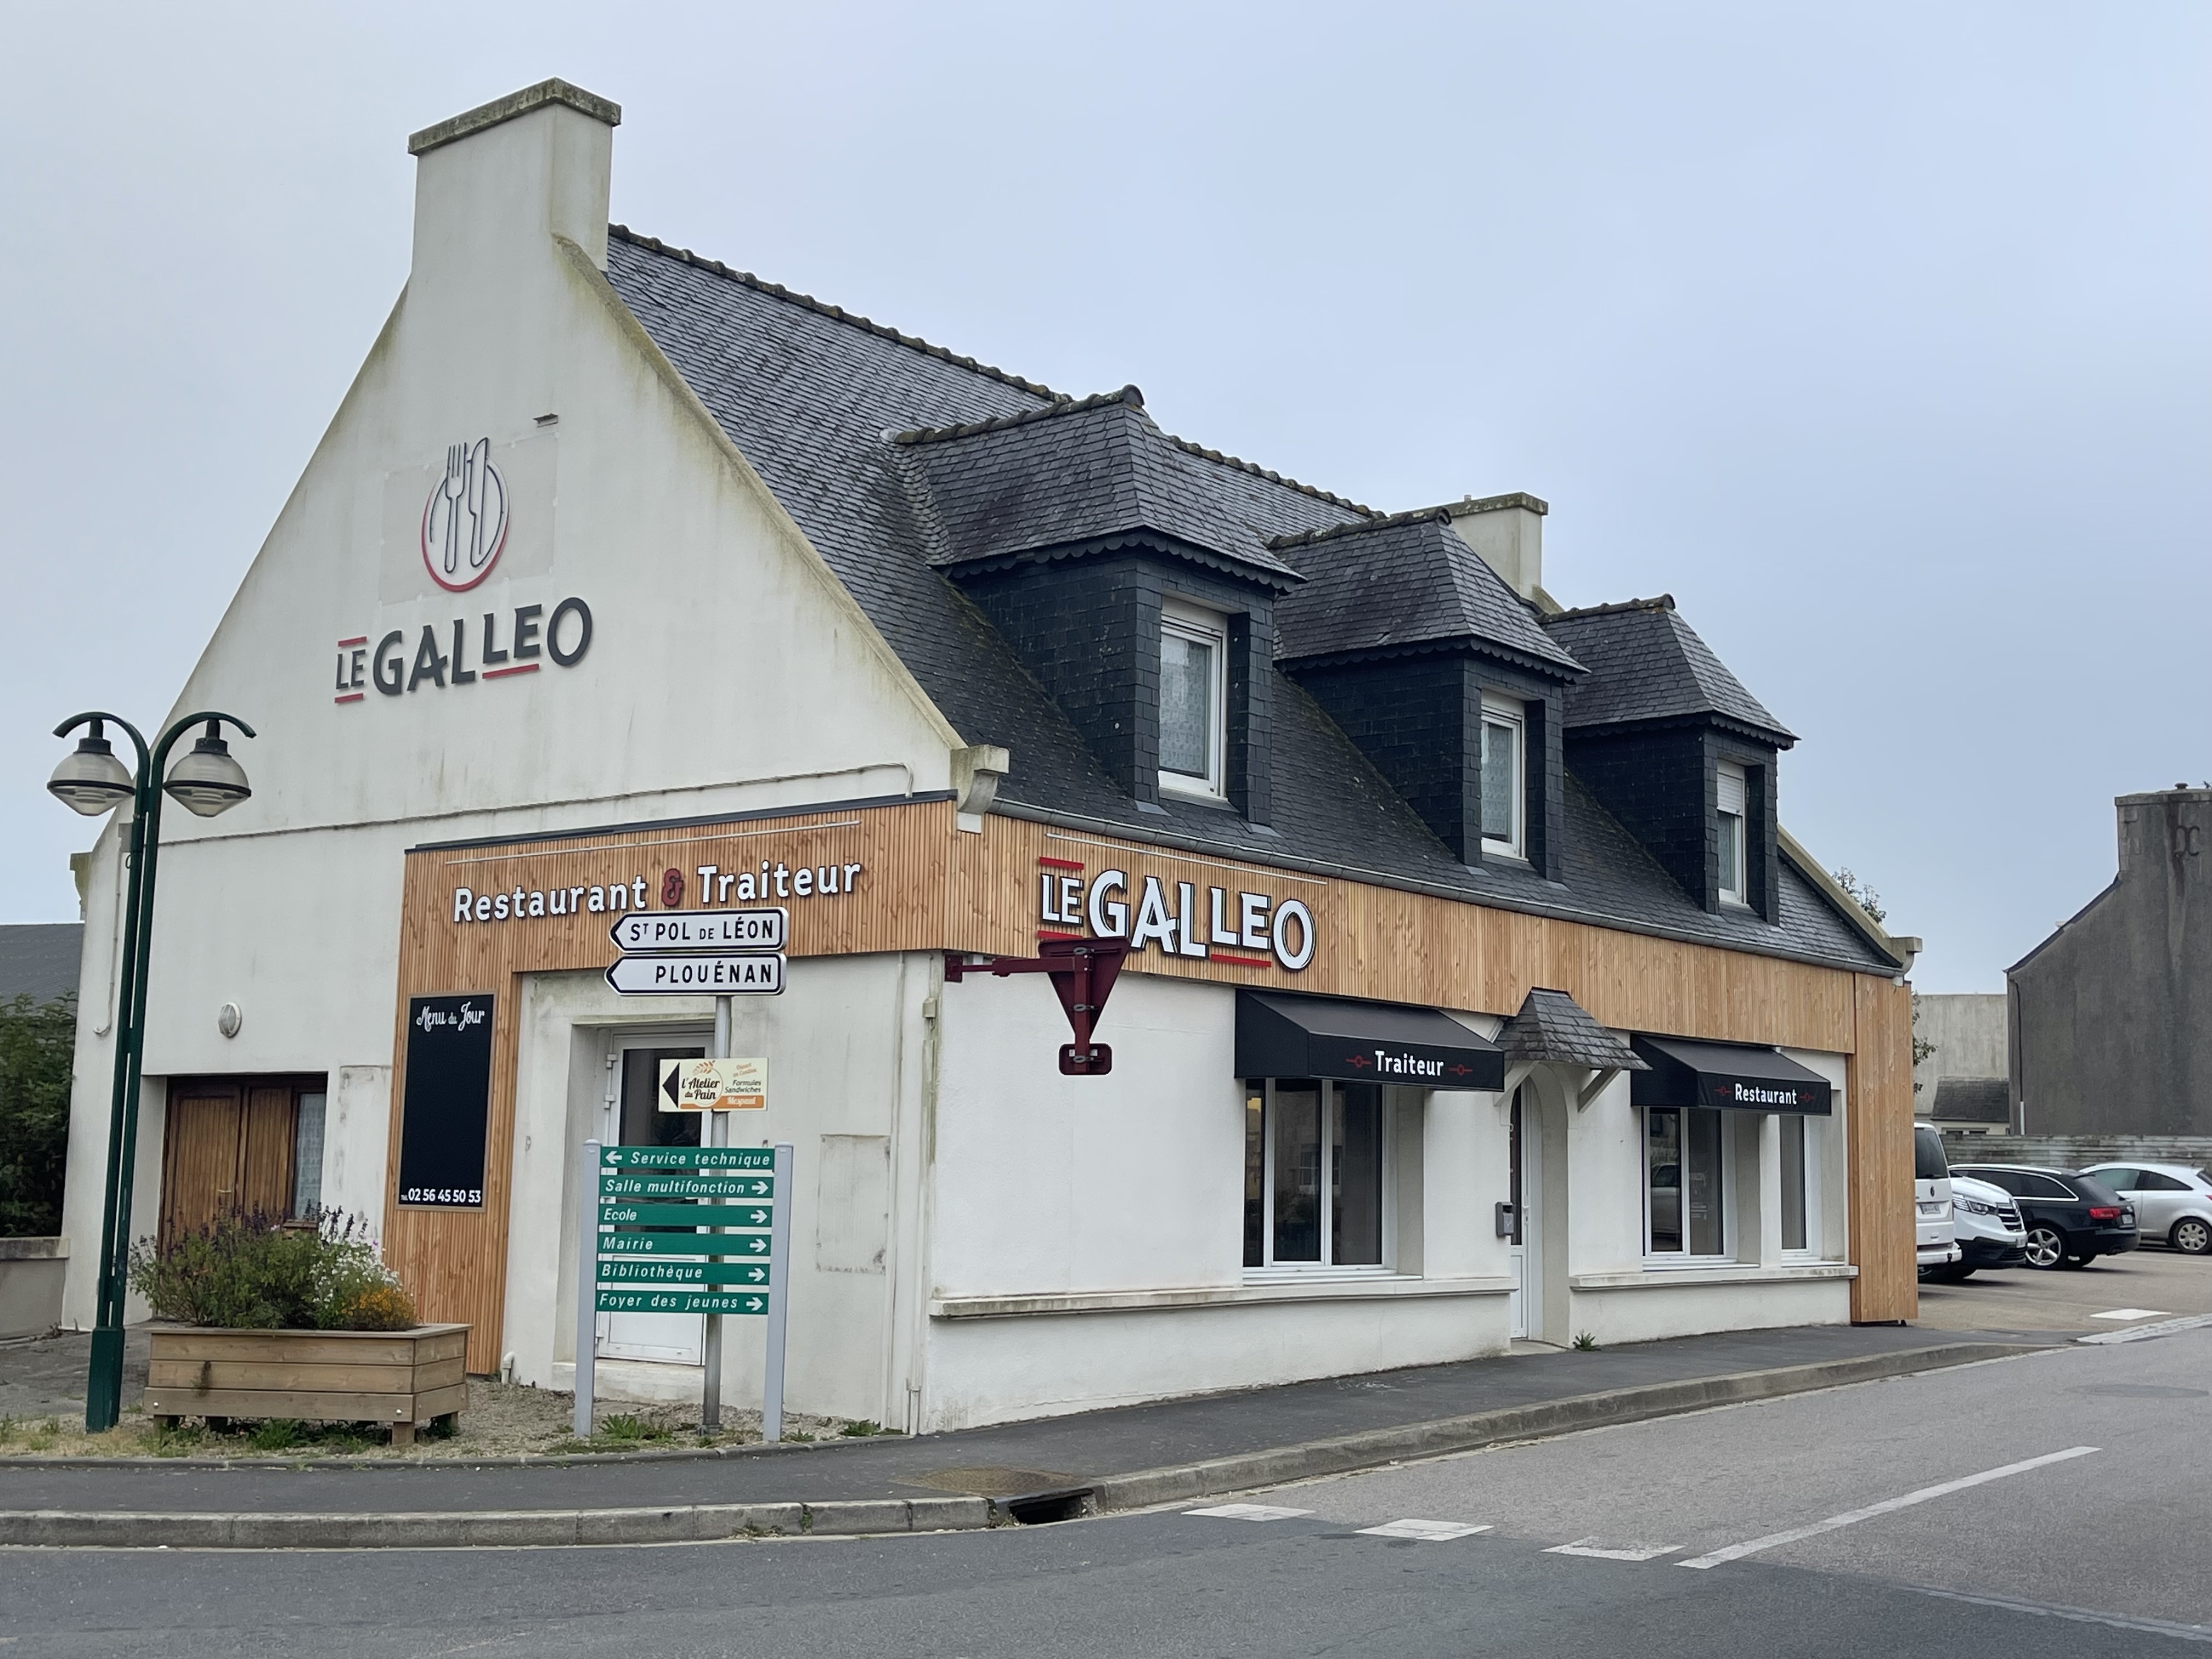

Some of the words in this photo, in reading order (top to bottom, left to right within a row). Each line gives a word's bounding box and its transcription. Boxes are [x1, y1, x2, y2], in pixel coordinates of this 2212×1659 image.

[336, 650, 366, 689] LE
[373, 597, 592, 695] GALLEO
[453, 876, 647, 922] Restaurant
[661, 868, 683, 907] &
[697, 861, 861, 903] Traiteur
[656, 922, 690, 940] POL
[699, 928, 714, 939] DE
[723, 917, 773, 939] LÉON
[1040, 873, 1084, 926] LE
[1088, 870, 1316, 970] GALLEO
[656, 961, 771, 983] PLOUÉNAN
[416, 1006, 447, 1032] Menu
[458, 1001, 485, 1031] Jour
[1375, 1050, 1444, 1076] Traiteur
[681, 1077, 720, 1090] l'Atelier
[694, 1089, 716, 1100] Pain
[1735, 1083, 1797, 1104] Restaurant
[630, 1152, 686, 1165] Service
[695, 1153, 770, 1168] technique
[605, 1179, 641, 1193] Salle
[647, 1180, 744, 1194] multifonction
[408, 1188, 421, 1201] 02
[422, 1188, 436, 1201] 56
[438, 1189, 451, 1202] 45
[453, 1189, 466, 1203] 50
[468, 1190, 481, 1203] 53
[604, 1208, 637, 1221] Ecole
[603, 1237, 653, 1250] Mairie
[602, 1263, 703, 1280] Bibliothèque
[600, 1293, 642, 1309] Foyer
[651, 1294, 676, 1307] des
[685, 1295, 738, 1310] jeunes
